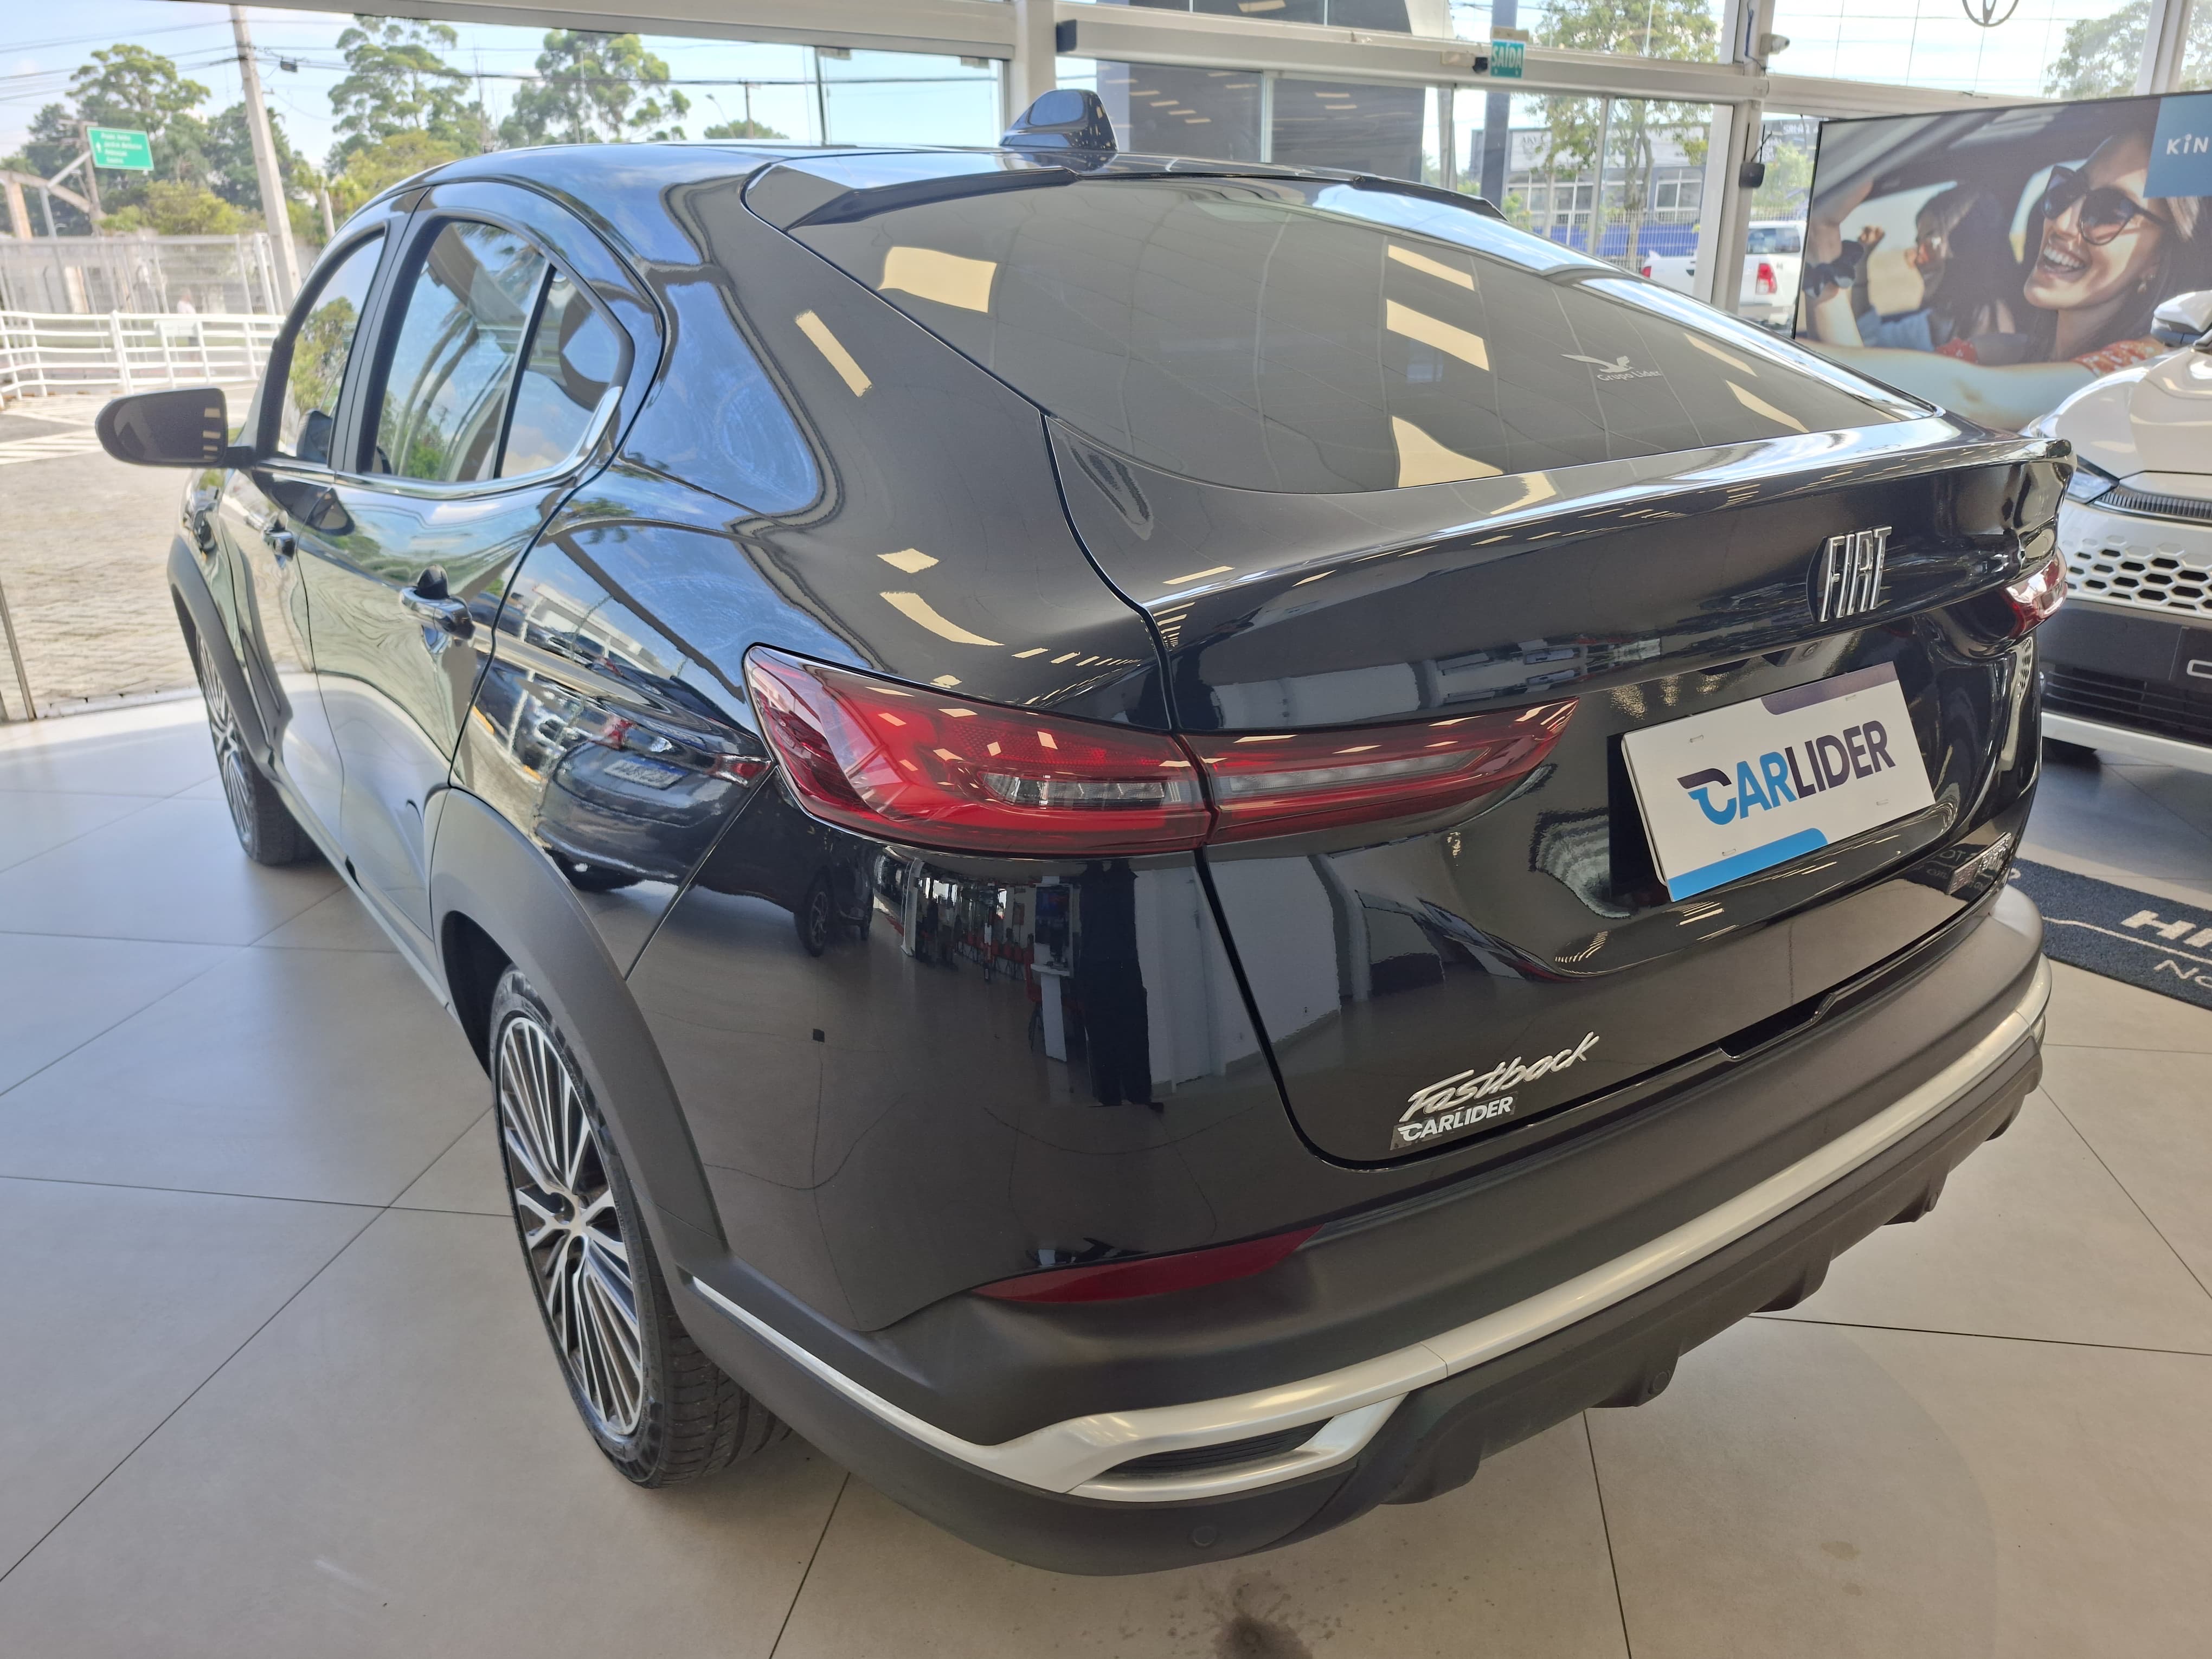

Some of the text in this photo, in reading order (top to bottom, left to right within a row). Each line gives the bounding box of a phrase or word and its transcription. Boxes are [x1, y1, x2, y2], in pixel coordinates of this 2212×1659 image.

[1491, 43, 1523, 69] SAÍDA
[1820, 525, 1893, 622] FIAT
[1677, 720, 1896, 825] CARLIDER
[1397, 1096, 1514, 1141] CARLIDER
[1398, 1031, 1600, 1123] Fastback
